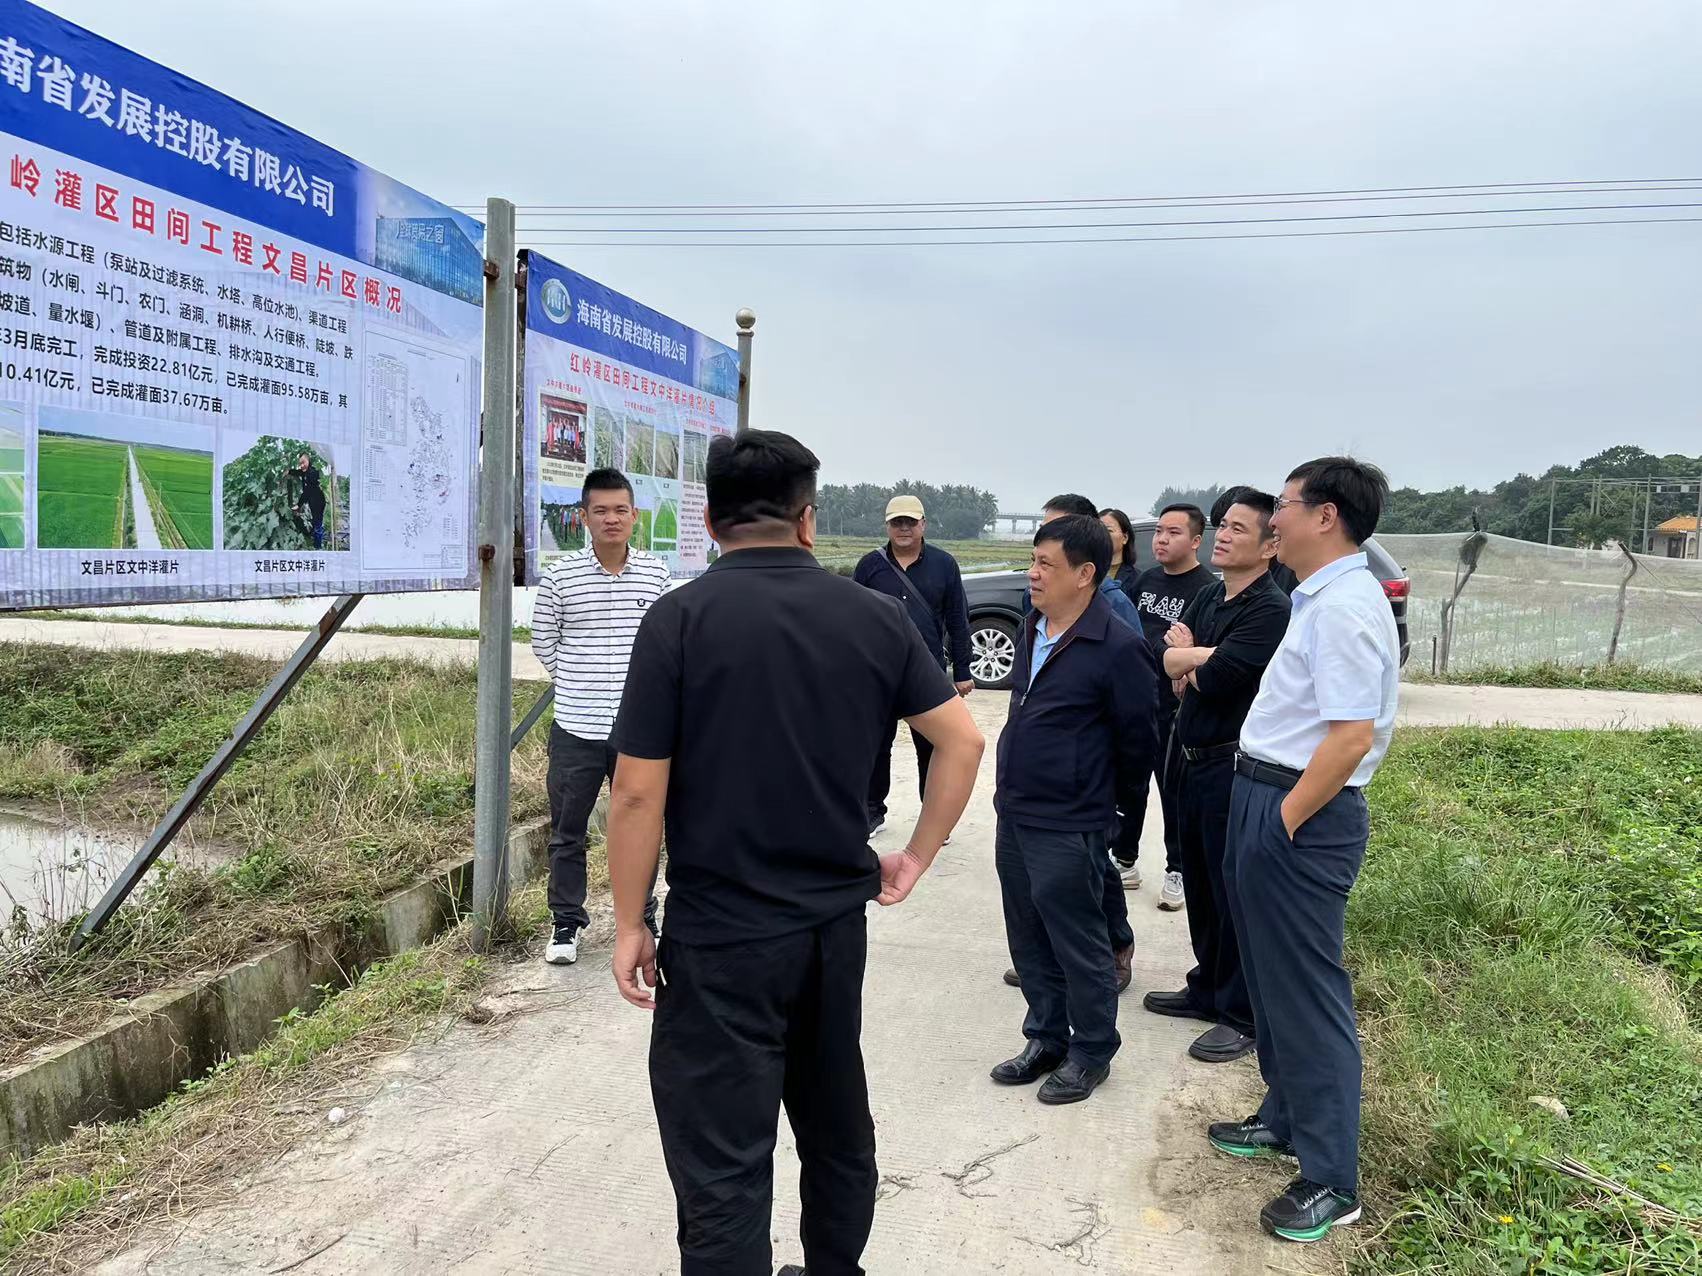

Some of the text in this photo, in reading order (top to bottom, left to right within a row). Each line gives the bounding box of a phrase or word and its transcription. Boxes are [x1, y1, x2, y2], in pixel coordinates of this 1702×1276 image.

[0, 37, 335, 217] 南省发展控股有限公司
[10, 153, 402, 314] 岭灌区田间工程文昌片区概况
[576, 299, 687, 365] 海南省发展控股有限公司
[81, 559, 179, 575] 文昌片区文中洋灌片
[254, 559, 326, 573] 文昌片区文中洋灌片
